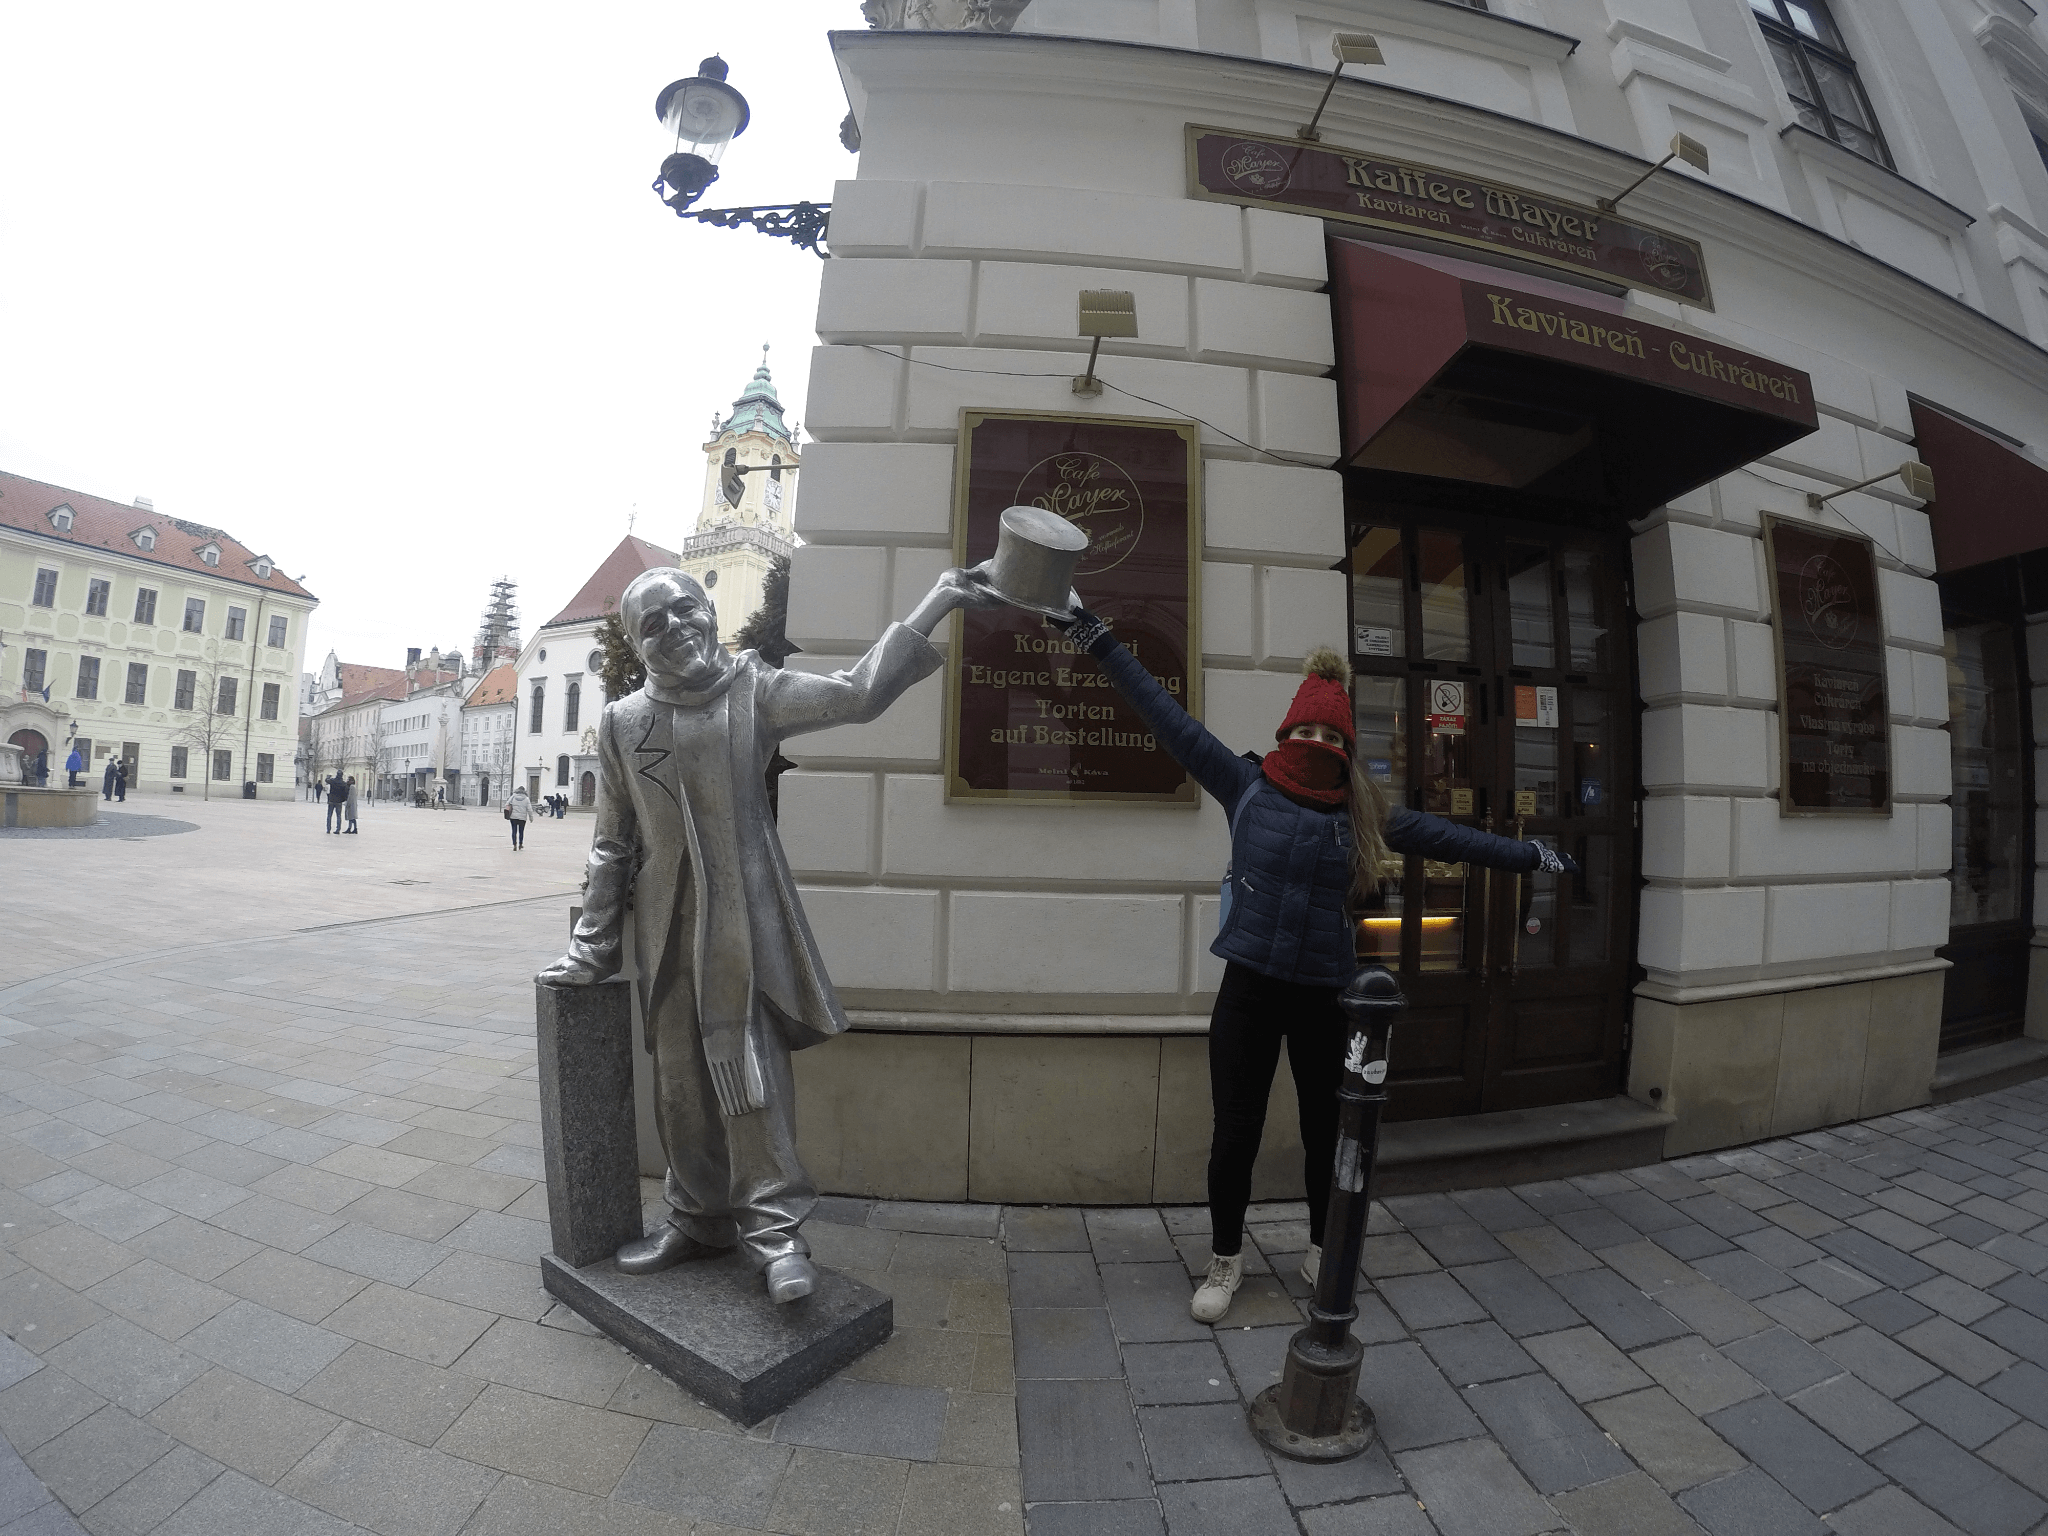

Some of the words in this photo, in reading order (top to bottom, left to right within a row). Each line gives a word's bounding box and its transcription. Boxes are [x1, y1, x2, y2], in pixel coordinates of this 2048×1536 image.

[1341, 156, 1475, 210] Kaffee
[1481, 187, 1599, 242] Mayer
[1356, 192, 1451, 225] Kaviareň
[1511, 226, 1598, 262] Cukráreň
[1486, 293, 1646, 360] Kaviareň
[1669, 340, 1801, 404] Cukráreň
[1056, 457, 1100, 488] Cafe
[969, 665, 1050, 689] Eigene
[1056, 667, 1181, 695] Erzeng
[1036, 699, 1115, 721] Torten
[990, 724, 1028, 744] auf
[1033, 725, 1157, 752] Bestellung
